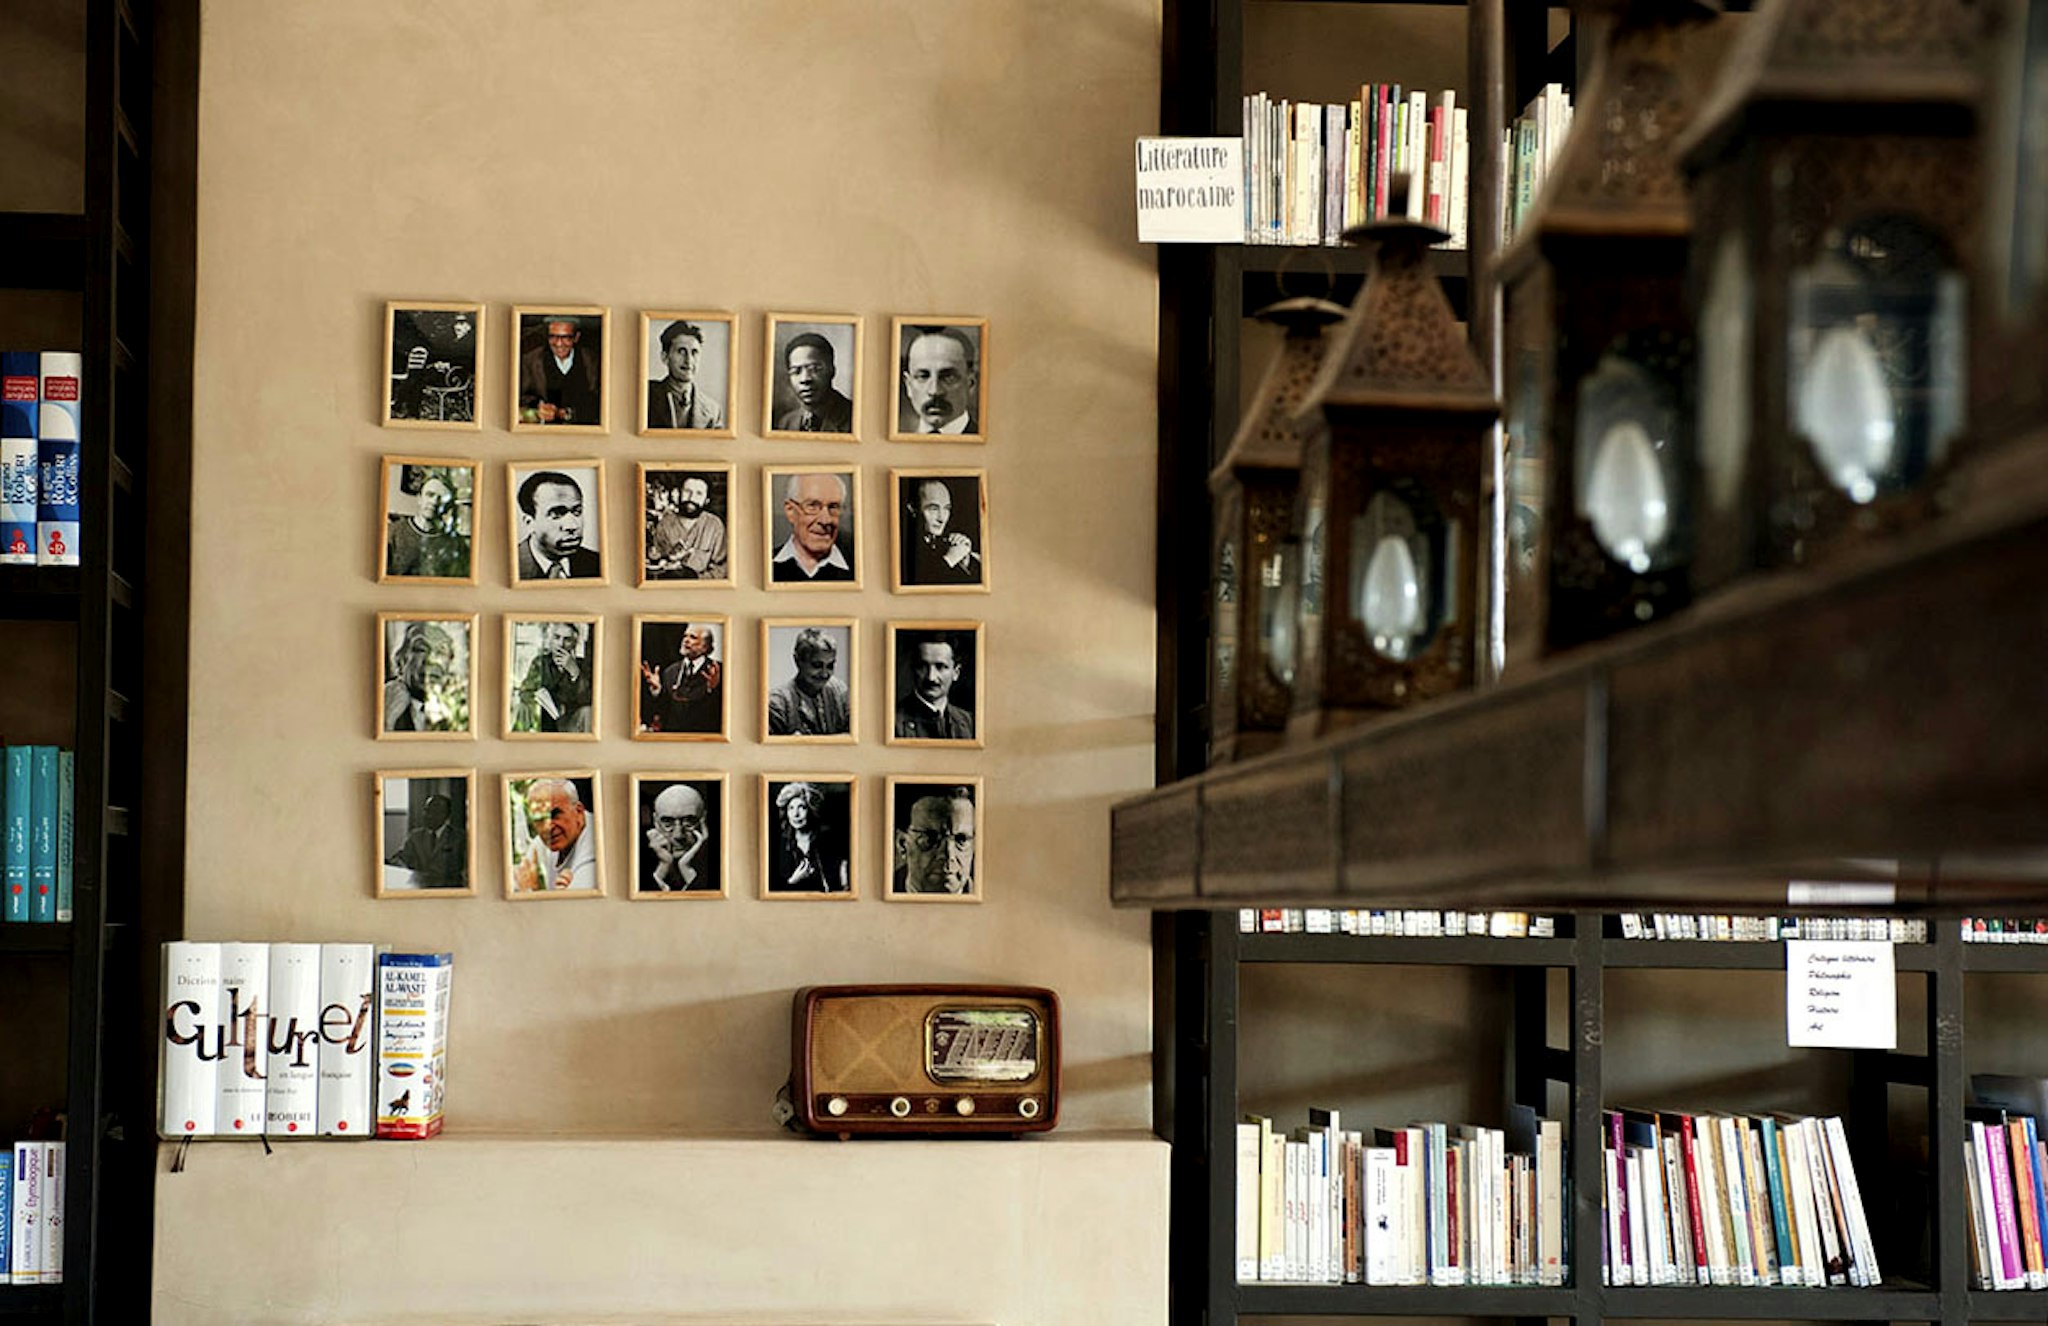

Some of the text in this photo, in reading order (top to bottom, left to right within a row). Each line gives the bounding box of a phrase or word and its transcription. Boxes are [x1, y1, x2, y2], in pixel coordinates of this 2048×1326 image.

[1138, 141, 1228, 172] Littérature
[1139, 175, 1235, 210] marocaine
[166, 986, 374, 1080] culturel
